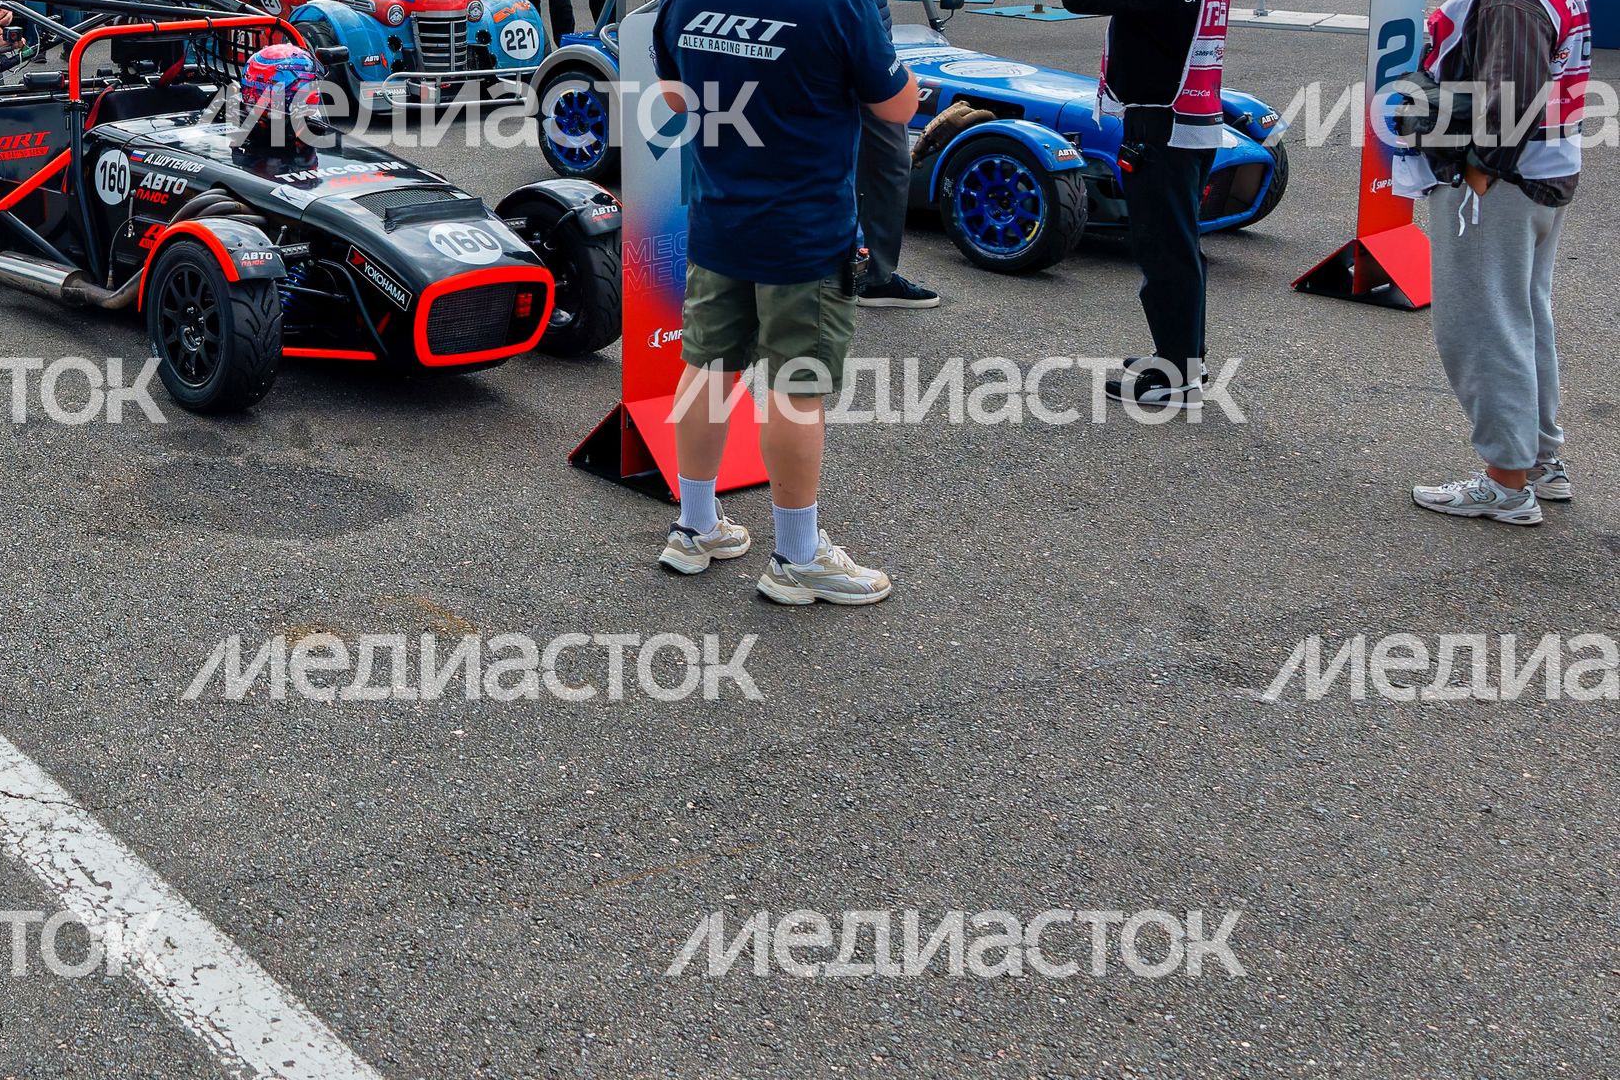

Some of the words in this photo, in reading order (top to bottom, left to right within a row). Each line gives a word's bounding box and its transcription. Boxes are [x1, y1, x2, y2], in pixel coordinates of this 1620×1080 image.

[683, 10, 797, 43] ART
[504, 28, 536, 51] 221
[682, 34, 705, 50] ALEX
[708, 38, 741, 54] RACING
[744, 43, 774, 59] TEAM
[1375, 18, 1416, 98] 2
[1261, 113, 1279, 124] АВТО
[143, 153, 206, 173] А.ШУТЕМОВ
[100, 160, 127, 193] 160
[140, 172, 189, 195] АВТО
[136, 187, 170, 205] ПЛЮС
[591, 204, 619, 217] АВТО
[241, 250, 273, 262] АВТО
[434, 226, 497, 261] 160
[621, 230, 688, 265] МЕС
[363, 261, 406, 305] YOKOHAMA
[621, 261, 688, 292] МЕС
